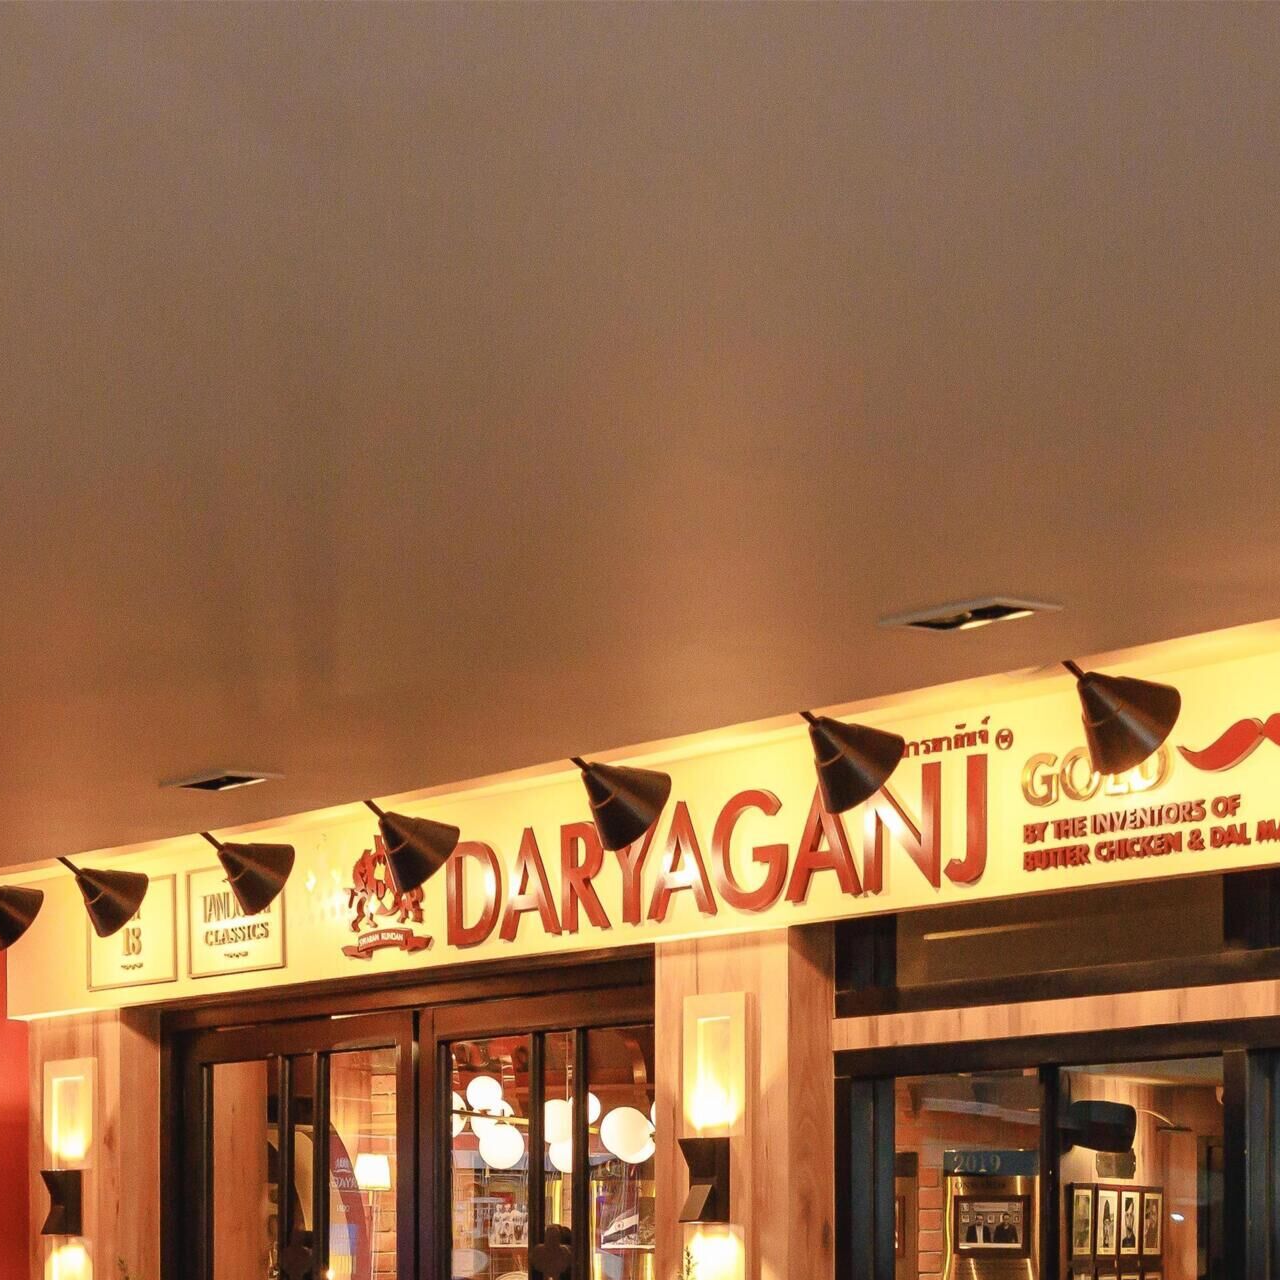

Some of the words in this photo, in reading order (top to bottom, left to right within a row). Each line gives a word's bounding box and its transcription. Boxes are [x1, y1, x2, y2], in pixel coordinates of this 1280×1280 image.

[1022, 822, 1049, 844] BY
[1051, 815, 1087, 840] THE
[1090, 799, 1207, 835] INVENTORS
[1210, 793, 1241, 819] OF
[447, 753, 988, 947] DARYAGANJ
[1022, 842, 1091, 872] BUTTER
[1094, 831, 1183, 863] CHICKEN
[1187, 828, 1206, 851] &
[1209, 822, 1251, 848] DAL
[121, 927, 142, 956] 18
[204, 921, 270, 947] CLASSICS
[953, 1153, 1001, 1175] 2019
